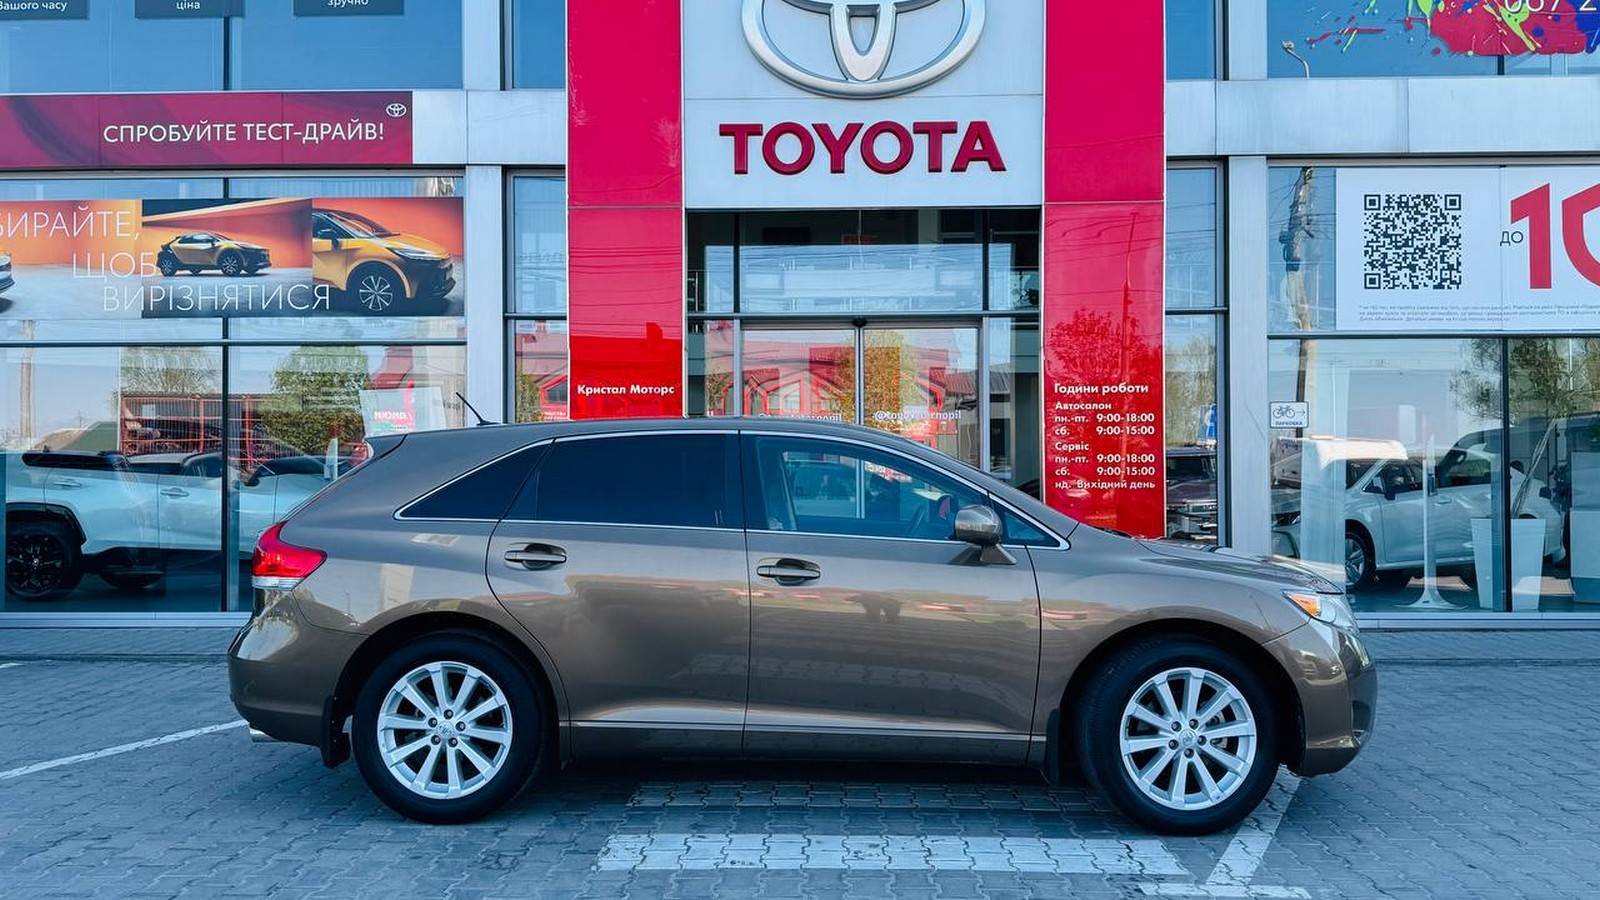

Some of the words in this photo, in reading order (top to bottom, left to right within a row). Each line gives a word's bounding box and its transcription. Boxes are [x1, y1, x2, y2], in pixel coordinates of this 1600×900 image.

[41, 2, 68, 12] часу
[176, 0, 200, 10] ціна
[103, 120, 237, 142] СПРОБУЙТЕ
[243, 118, 384, 144] ТЕСТ-ДРАЙВ!
[719, 121, 1007, 175] TOYOTA
[0, 205, 140, 240] ИРАЙТЕ,
[72, 252, 157, 280] ЩОБ
[103, 284, 331, 311] ВИРІЗНЯТИСЯ
[577, 385, 626, 396] Кристал
[630, 384, 675, 396] Моторс
[1054, 383, 1099, 394] Години
[1102, 382, 1149, 395] роботи
[1055, 401, 1112, 410] Автосалон
[1096, 413, 1155, 423] 9:00-18:00
[1096, 426, 1155, 436] 9:00-15:00
[1055, 442, 1090, 453] Сервіс
[1096, 453, 1155, 464] 9:00-18:00
[1096, 466, 1156, 476] 9:00-15:00
[1055, 481, 1072, 489] нд.
[1076, 479, 1127, 490] Вихідний
[1129, 481, 1156, 490] день
